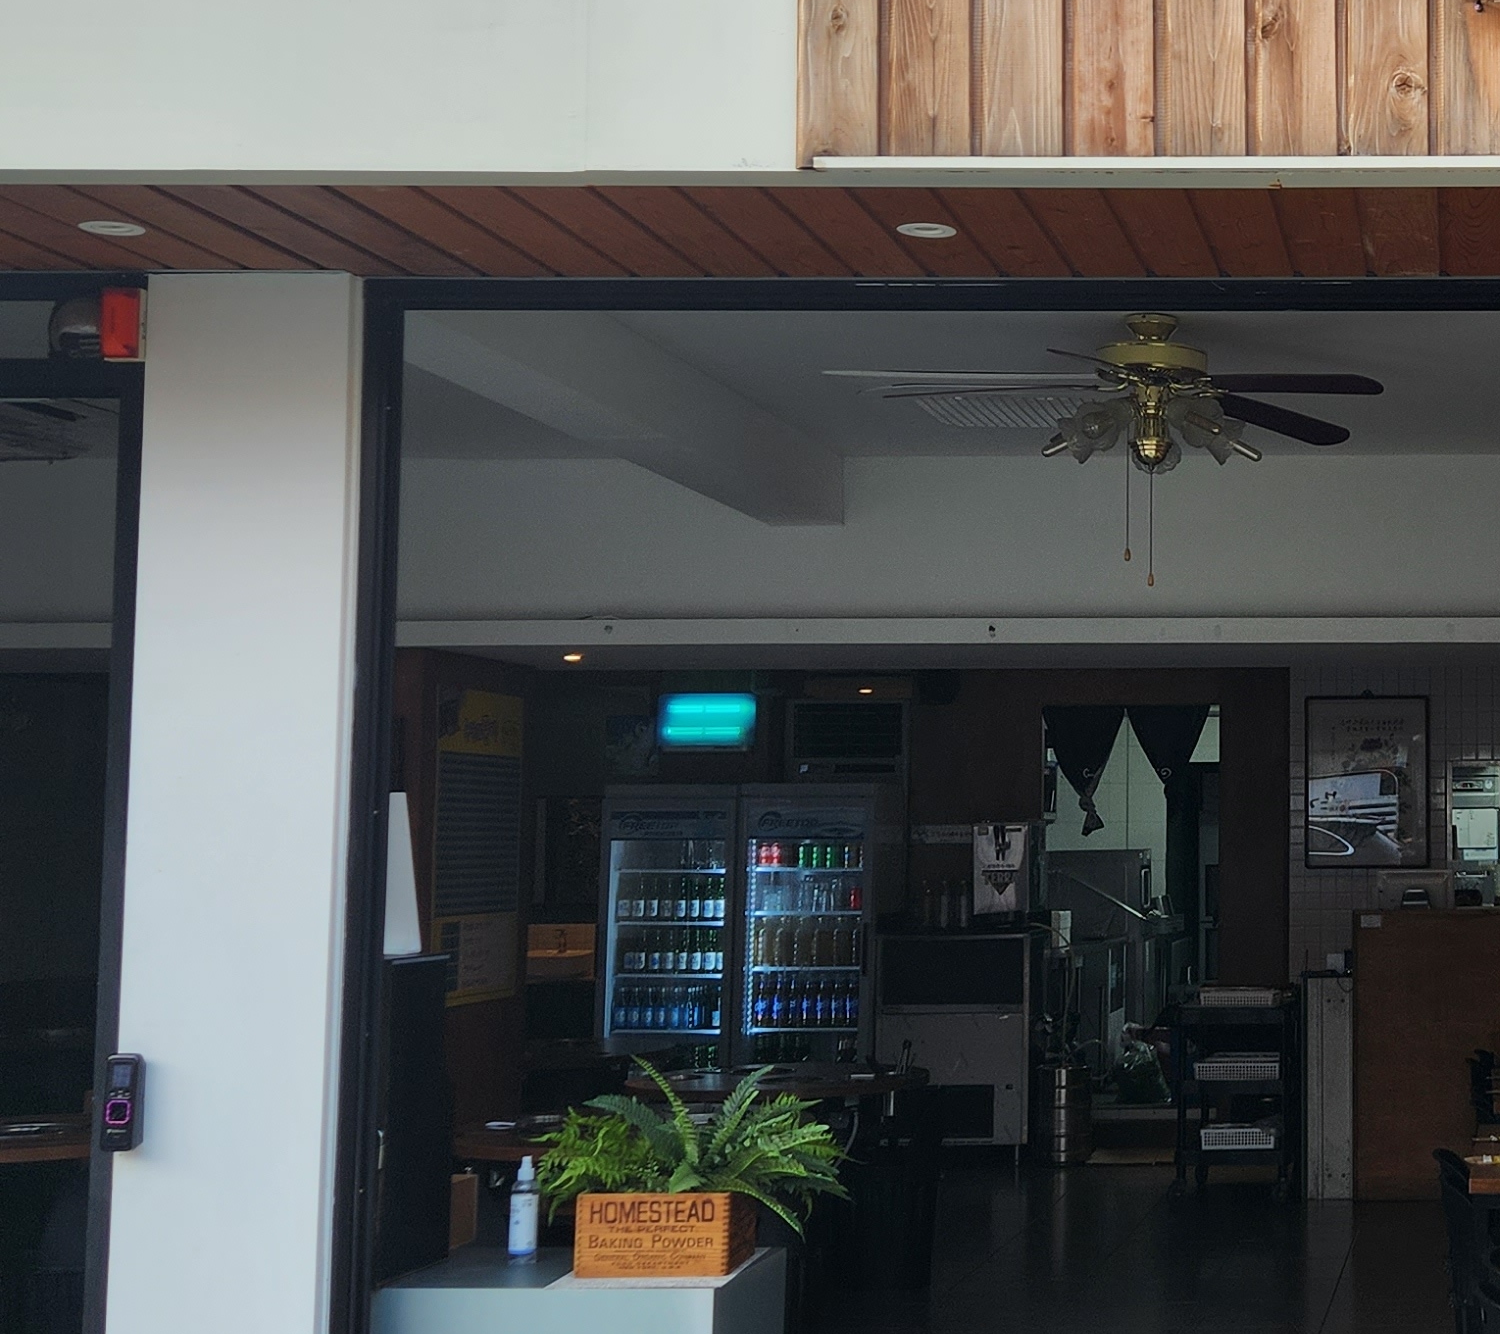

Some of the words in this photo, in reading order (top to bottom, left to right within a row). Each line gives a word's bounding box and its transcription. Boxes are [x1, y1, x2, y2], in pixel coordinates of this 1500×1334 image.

[589, 1199, 715, 1224] HOMESTEAD
[588, 1234, 643, 1249] BAKING
[651, 1234, 714, 1249] POWDER
